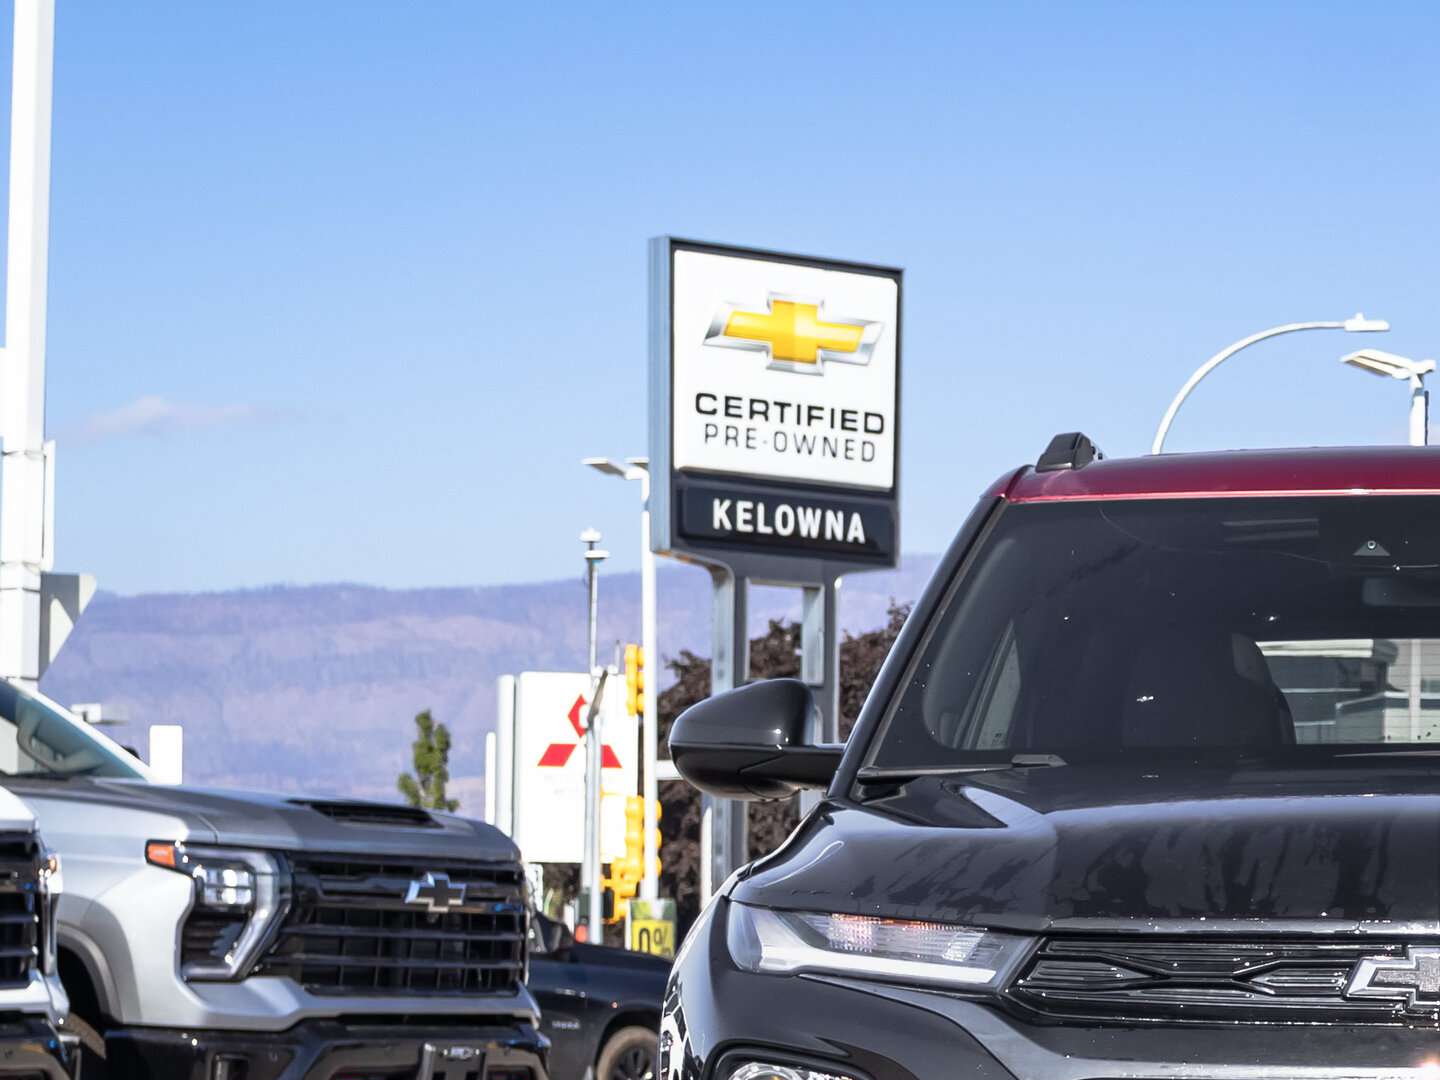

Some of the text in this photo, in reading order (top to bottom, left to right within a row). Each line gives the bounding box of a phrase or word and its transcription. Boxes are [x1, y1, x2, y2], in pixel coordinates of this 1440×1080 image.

[694, 392, 885, 435] CERTIFIED
[704, 423, 875, 462] PRE-OWNED
[712, 498, 866, 543] KELOWNA
